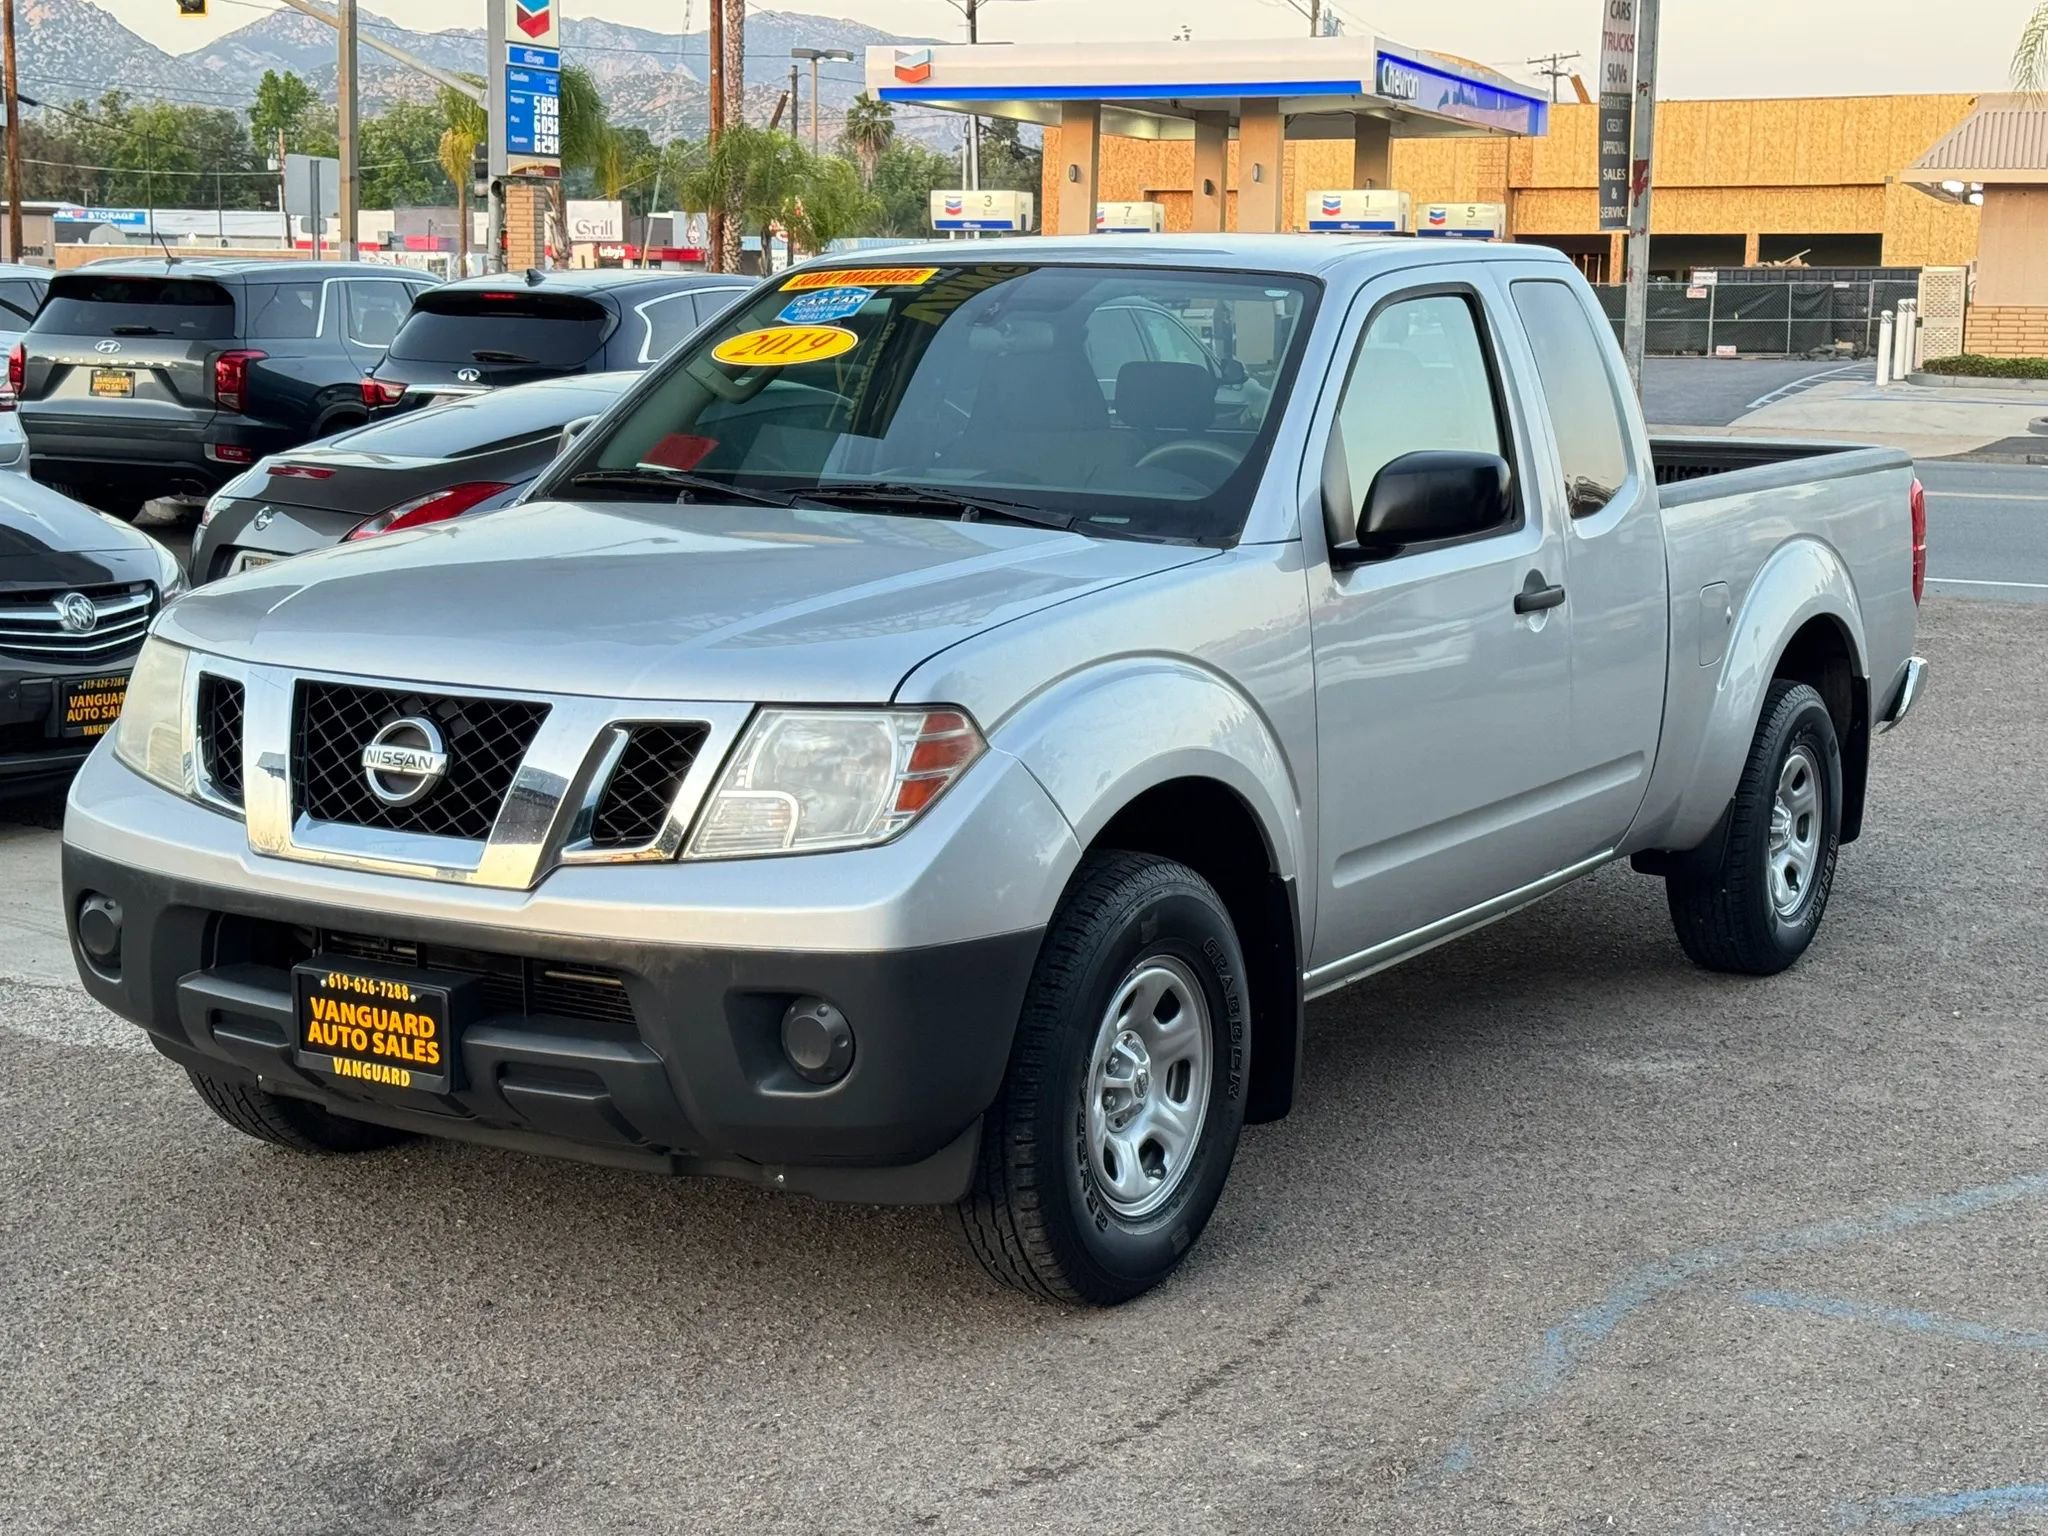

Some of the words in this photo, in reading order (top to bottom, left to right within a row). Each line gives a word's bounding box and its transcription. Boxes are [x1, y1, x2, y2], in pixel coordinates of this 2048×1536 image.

[1610, 1, 1631, 21] CARS
[1603, 31, 1634, 53] TRUCKS
[1382, 58, 1419, 99] Chevron
[1607, 62, 1627, 84] SUVs
[1603, 167, 1626, 181] SALES
[983, 195, 993, 208] 3
[1365, 194, 1370, 208] 1
[1611, 187, 1618, 200] &
[87, 211, 136, 220] STORAGE
[1124, 206, 1132, 217] 7
[1467, 206, 1476, 218] 5
[575, 219, 613, 235] Grill
[790, 271, 834, 289] LOW
[832, 268, 925, 287] MILEAGE
[796, 294, 867, 306] CARFAX
[726, 332, 839, 356] 2019
[69, 692, 127, 709] VANGUAR
[66, 707, 100, 722] AUTO
[101, 705, 121, 719] SAL
[83, 723, 110, 736] VANGU
[365, 749, 434, 770] NISSAN
[328, 972, 409, 1001] 619-626-7288
[310, 996, 436, 1039] VANGUARD
[308, 1021, 368, 1051] AUTO
[372, 1032, 440, 1065] SALES
[333, 1057, 411, 1087] VANGUARD
